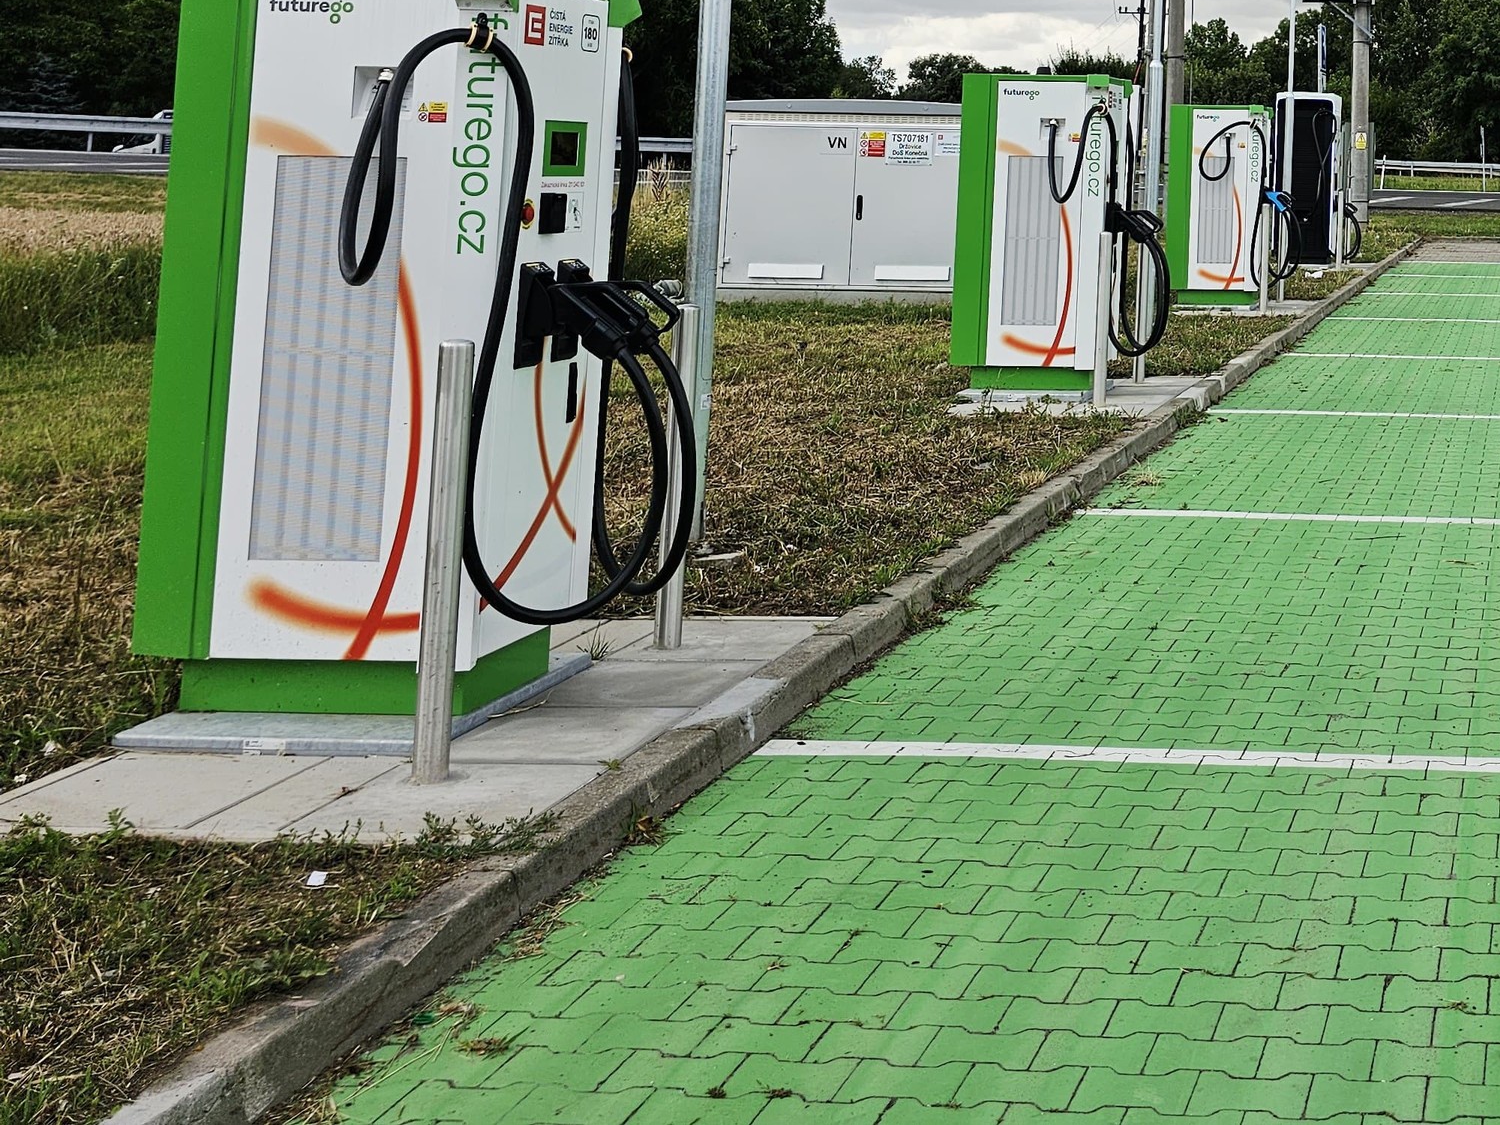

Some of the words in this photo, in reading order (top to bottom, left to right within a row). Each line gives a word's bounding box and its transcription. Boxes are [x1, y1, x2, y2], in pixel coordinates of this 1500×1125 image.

[549, 7, 567, 22] ČISTÁ
[549, 23, 573, 35] ENERGIE
[583, 26, 598, 41] 180
[548, 34, 569, 47] ZÍTŘKA
[1003, 88, 1040, 101] futurego
[452, 13, 509, 255] fturego.cz
[892, 133, 929, 143] TS707181
[827, 136, 847, 149] VN
[1085, 96, 1103, 197] turego.cz
[1249, 128, 1260, 183] turego.cz
